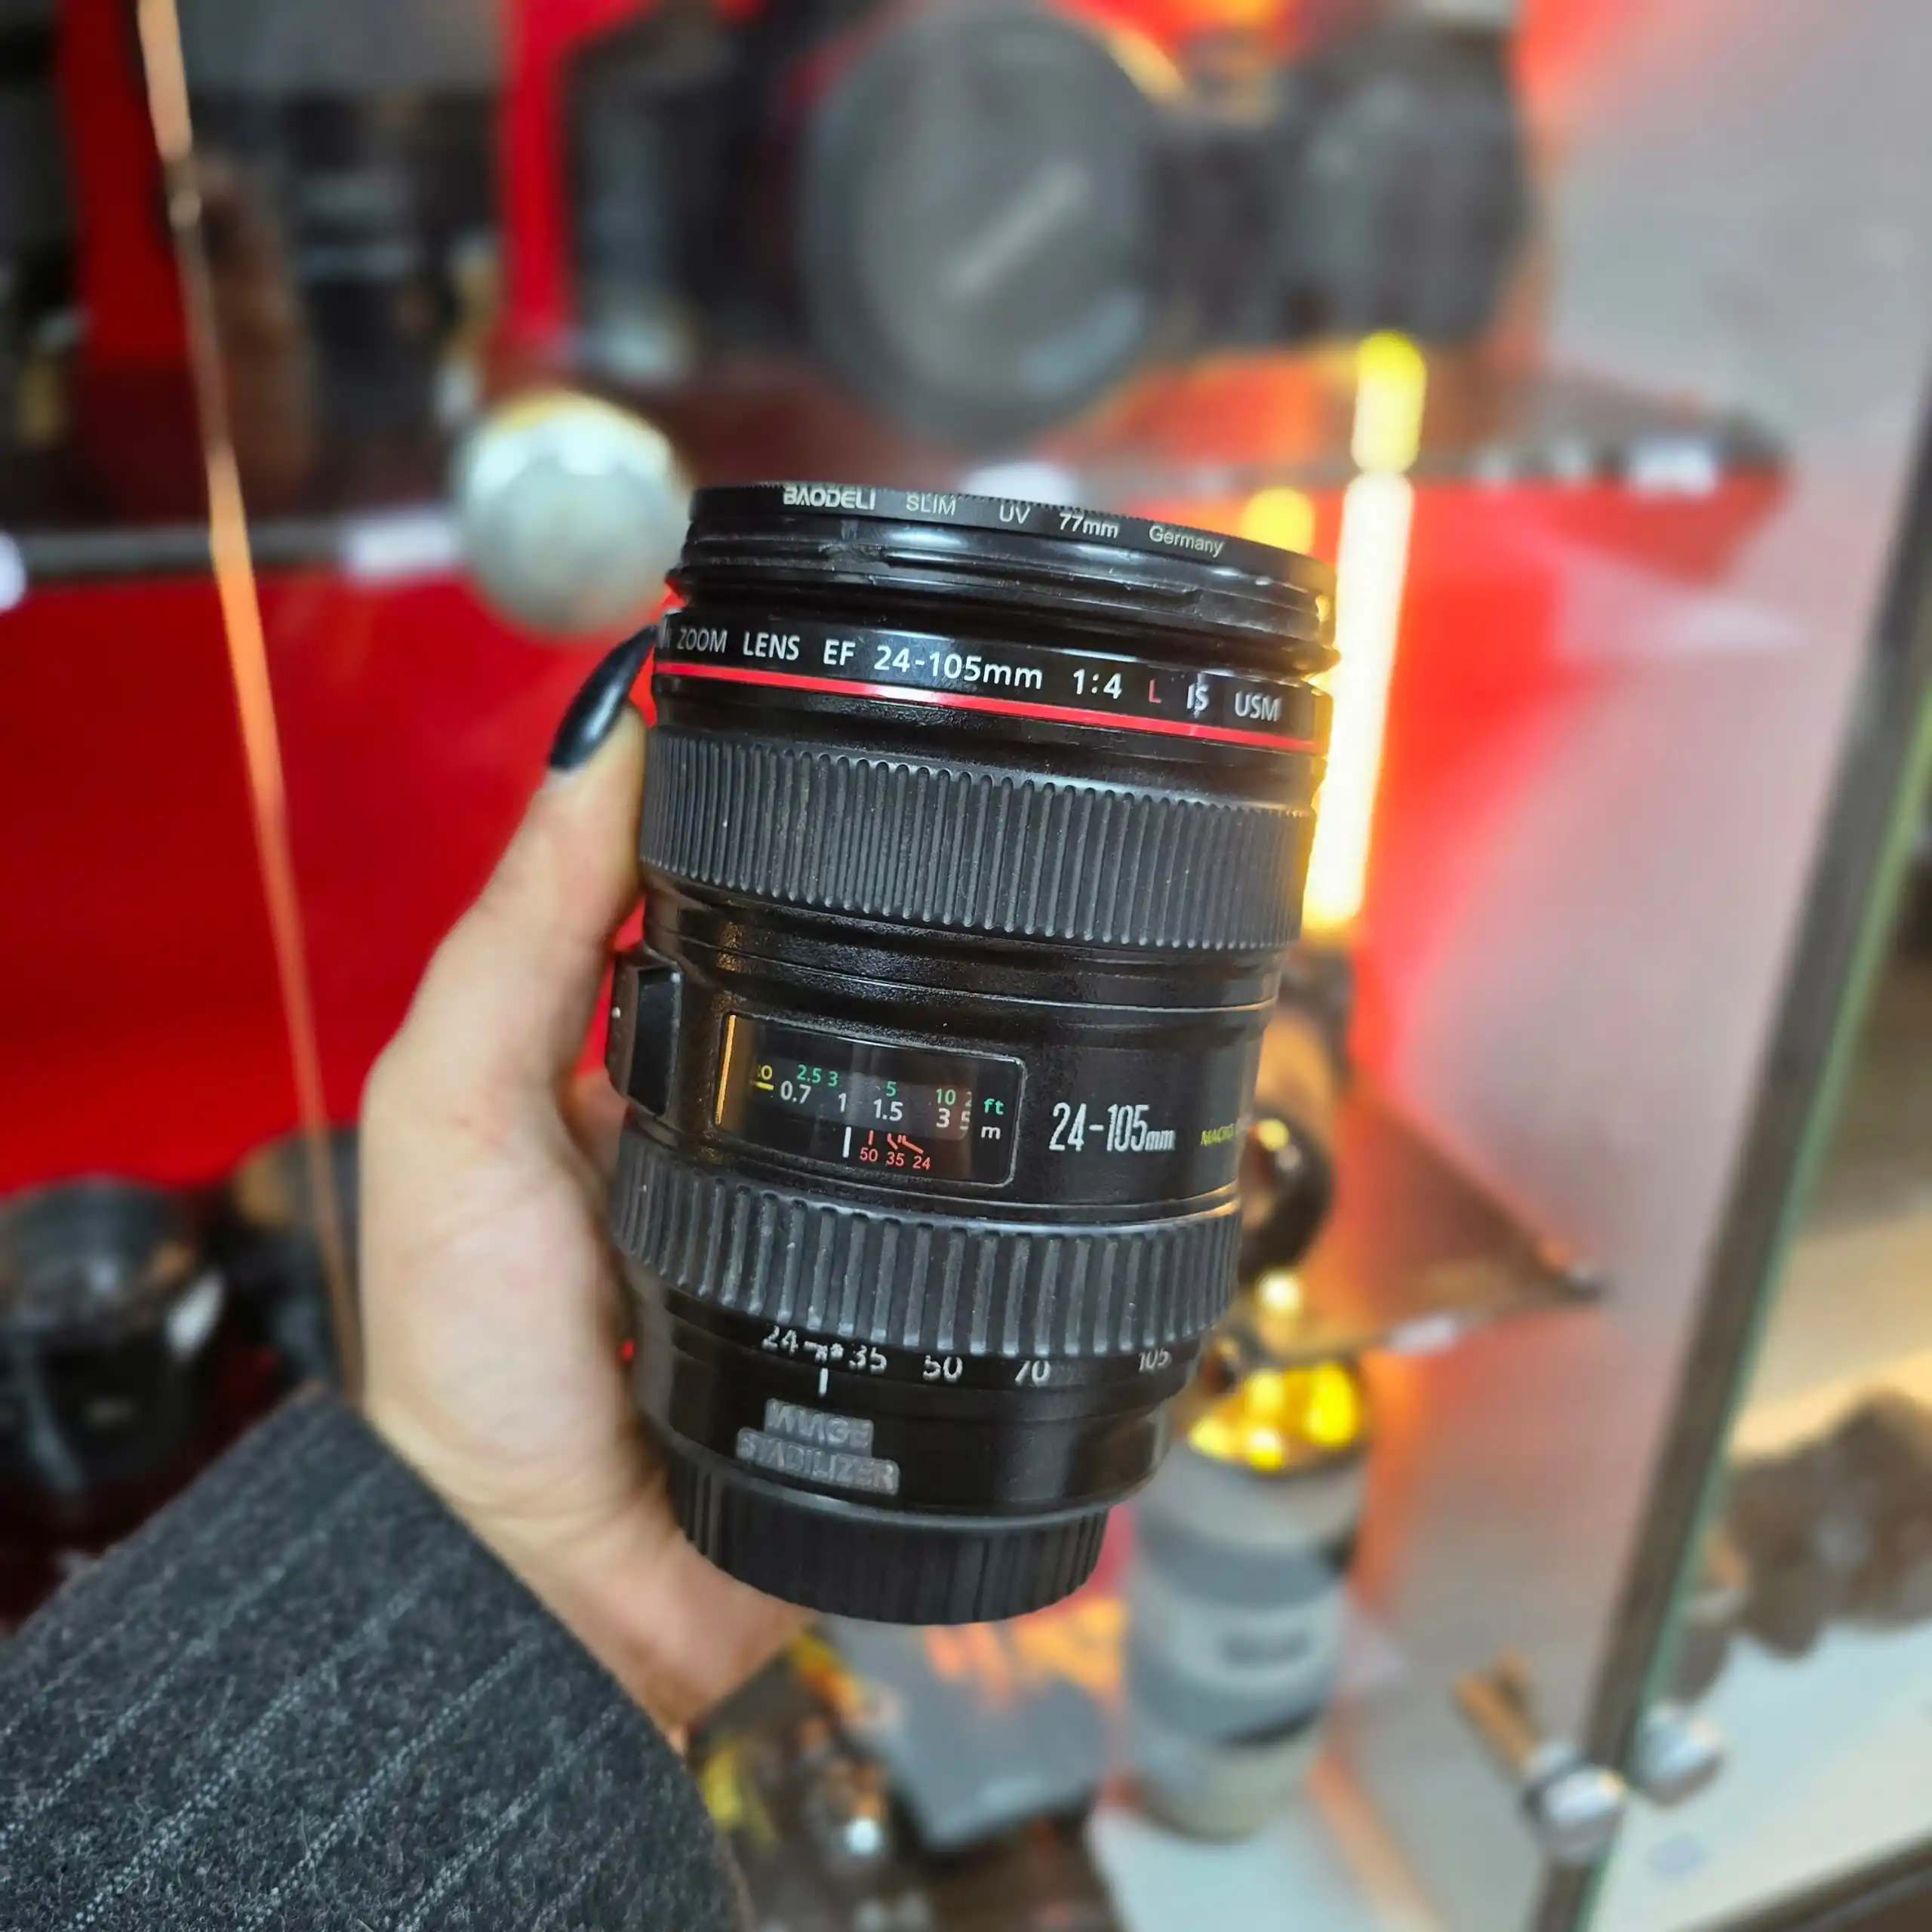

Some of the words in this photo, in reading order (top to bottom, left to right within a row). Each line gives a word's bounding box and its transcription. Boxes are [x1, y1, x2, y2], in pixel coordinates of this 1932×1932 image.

[783, 485, 875, 511] BAODELI
[906, 492, 957, 518] SLIM
[998, 503, 1031, 525] UV
[1057, 511, 1120, 539] 77mm
[1148, 523, 1225, 558] Germany
[676, 626, 728, 654] ZOOM
[743, 631, 801, 661] LENS
[823, 639, 856, 666] EF
[873, 645, 1044, 690] 24-105mm
[1072, 669, 1123, 700] 1:4
[1148, 678, 1162, 704] L
[1186, 681, 1210, 712] IS
[1233, 691, 1282, 722] USM
[780, 1080, 812, 1104] 0.7
[838, 1092, 848, 1113] 1
[873, 1099, 904, 1121] 1.5
[936, 1107, 951, 1128] 3
[981, 1126, 1001, 1140] m
[796, 1064, 822, 1084] 2.5
[827, 1070, 838, 1088] 3
[885, 1081, 897, 1097] 5
[936, 1088, 956, 1106] 10
[983, 1098, 1004, 1115] ft
[1048, 1102, 1176, 1152] 24-105mm
[859, 1148, 878, 1163] 50
[885, 1152, 905, 1168] 35
[912, 1155, 931, 1171] 24
[761, 1325, 798, 1355] 24
[848, 1345, 888, 1375] 35
[921, 1354, 964, 1383] 50
[1137, 1348, 1171, 1372] 105
